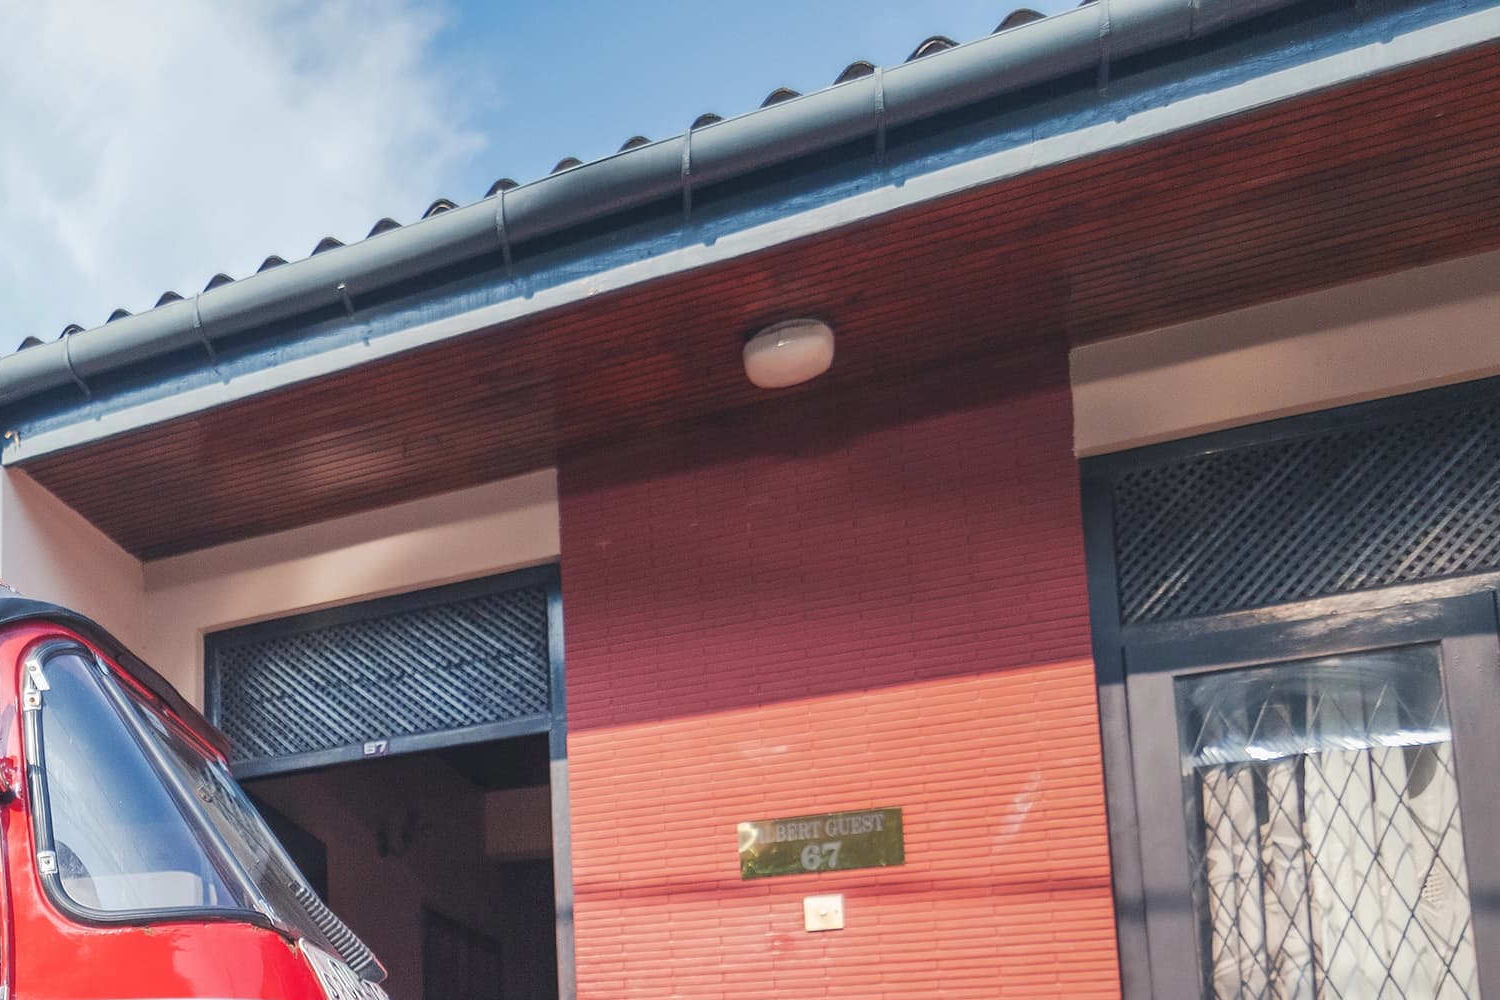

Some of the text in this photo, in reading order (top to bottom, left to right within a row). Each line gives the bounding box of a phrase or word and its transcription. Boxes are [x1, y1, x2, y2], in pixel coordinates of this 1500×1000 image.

[363, 740, 388, 755] 67
[825, 812, 886, 837] GUEST
[801, 840, 842, 870] 67
